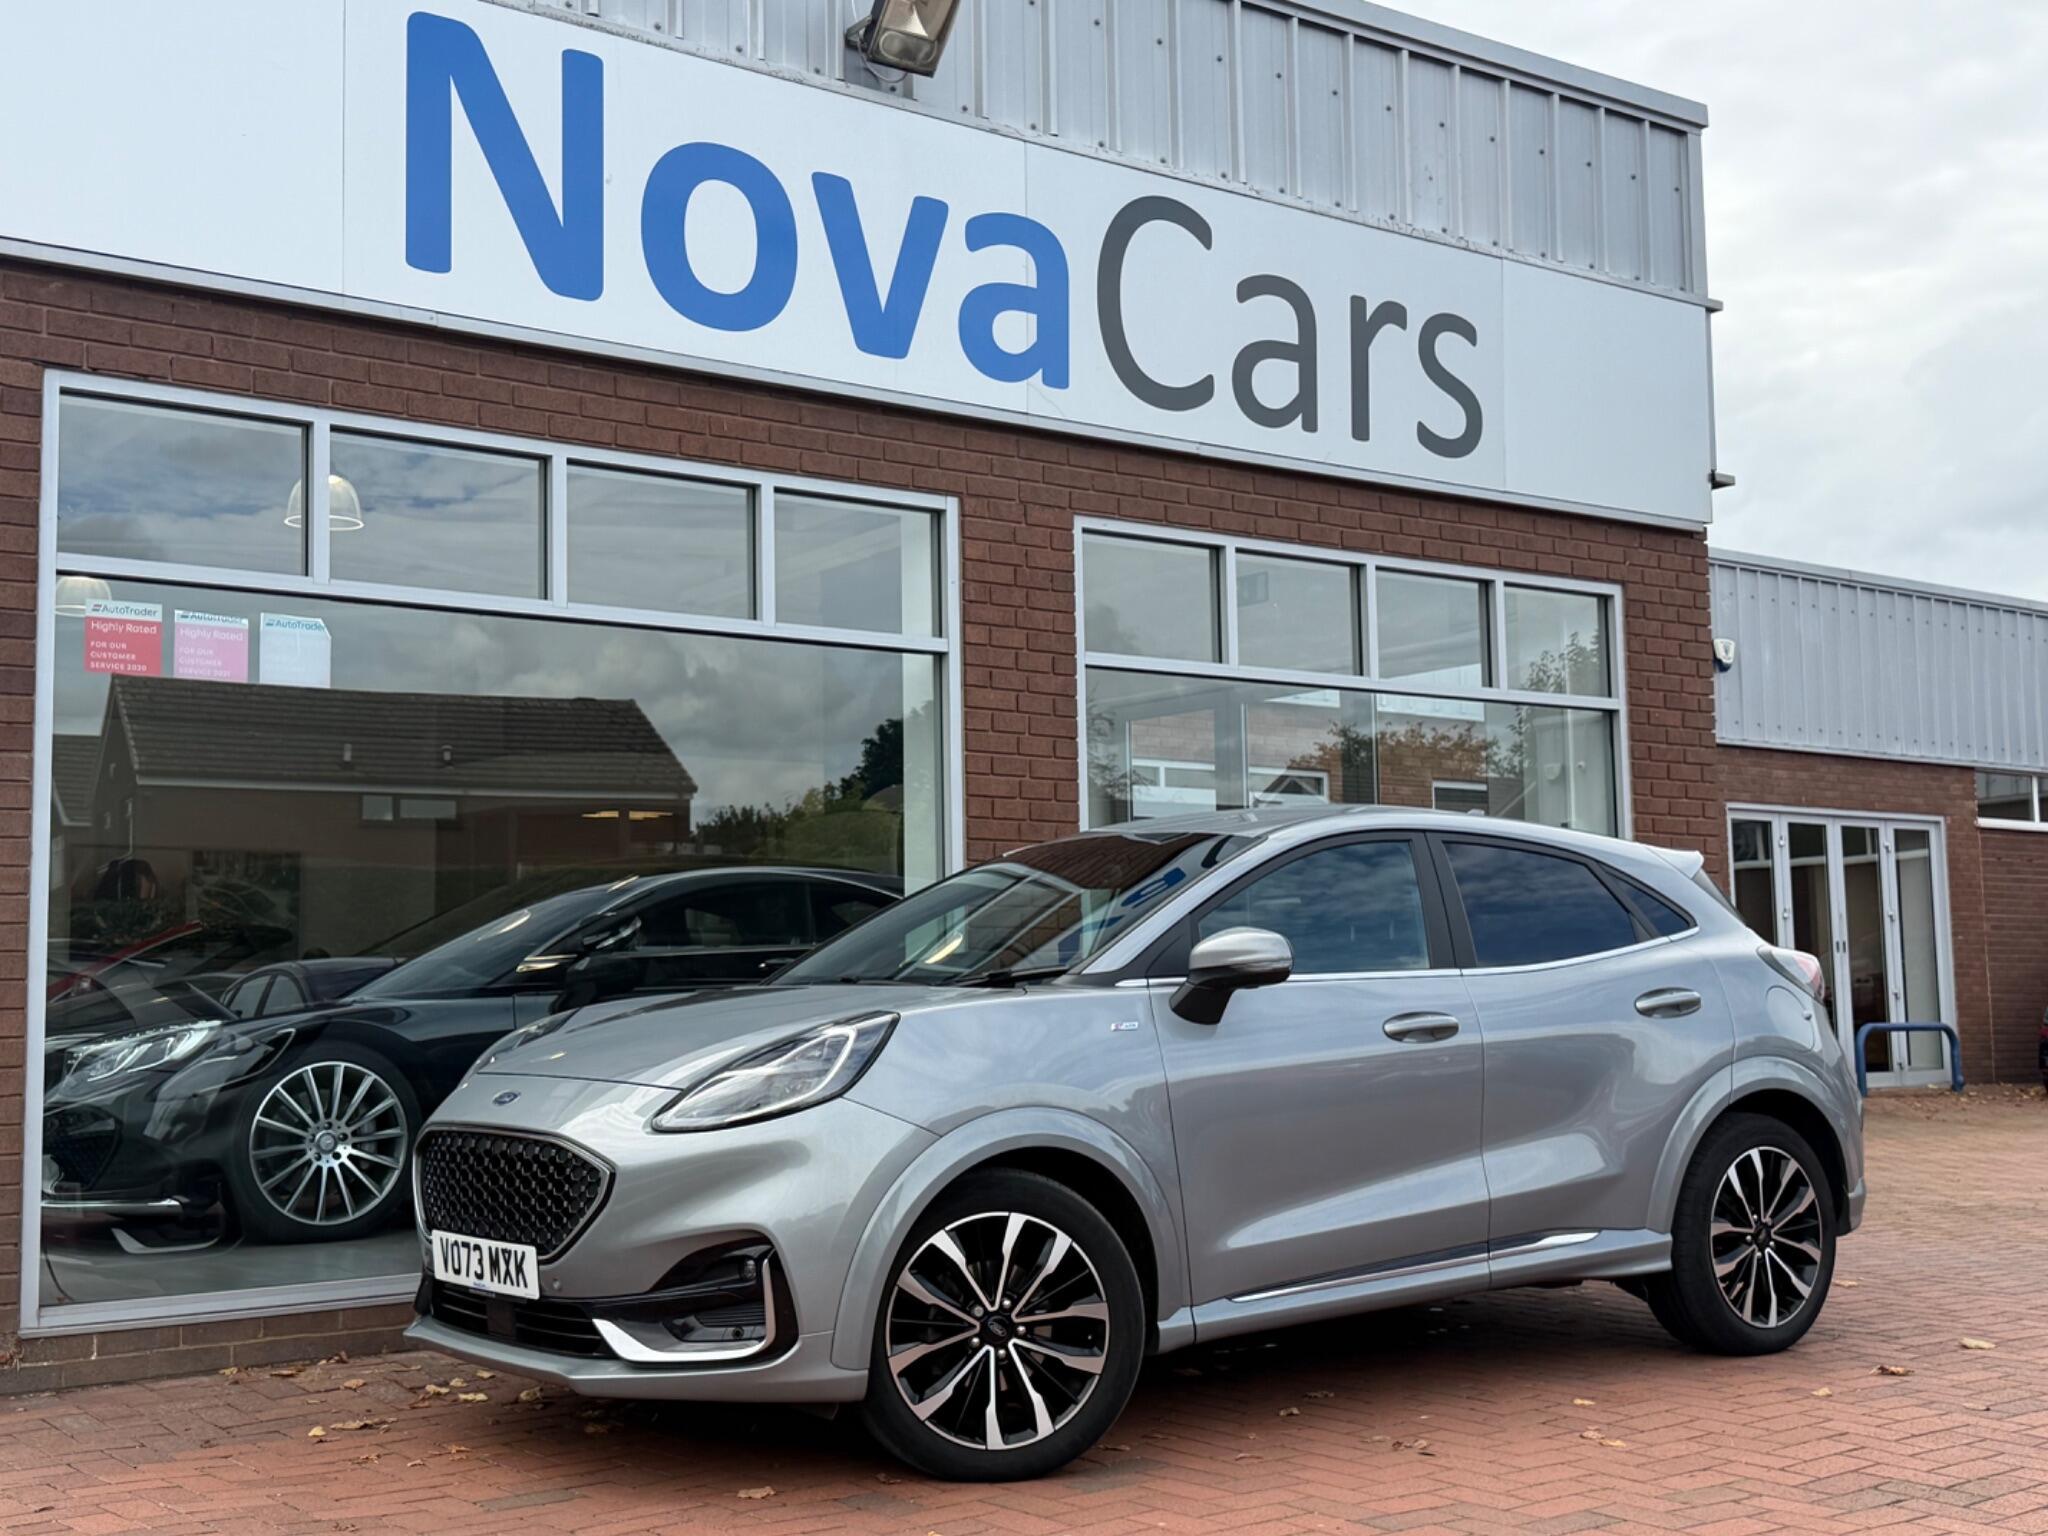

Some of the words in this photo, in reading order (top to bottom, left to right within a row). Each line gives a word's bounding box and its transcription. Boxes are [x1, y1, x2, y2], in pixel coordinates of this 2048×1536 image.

[101, 604, 158, 617] AutoTrader
[91, 620, 124, 635] Highly
[125, 623, 157, 634] Rated
[90, 640, 107, 649] FOR
[109, 641, 127, 650] OUR
[90, 651, 136, 661] CUSTOMER
[90, 660, 125, 671] SERVICE
[440, 1236, 485, 1281] VO73
[488, 1245, 528, 1289] MXK
